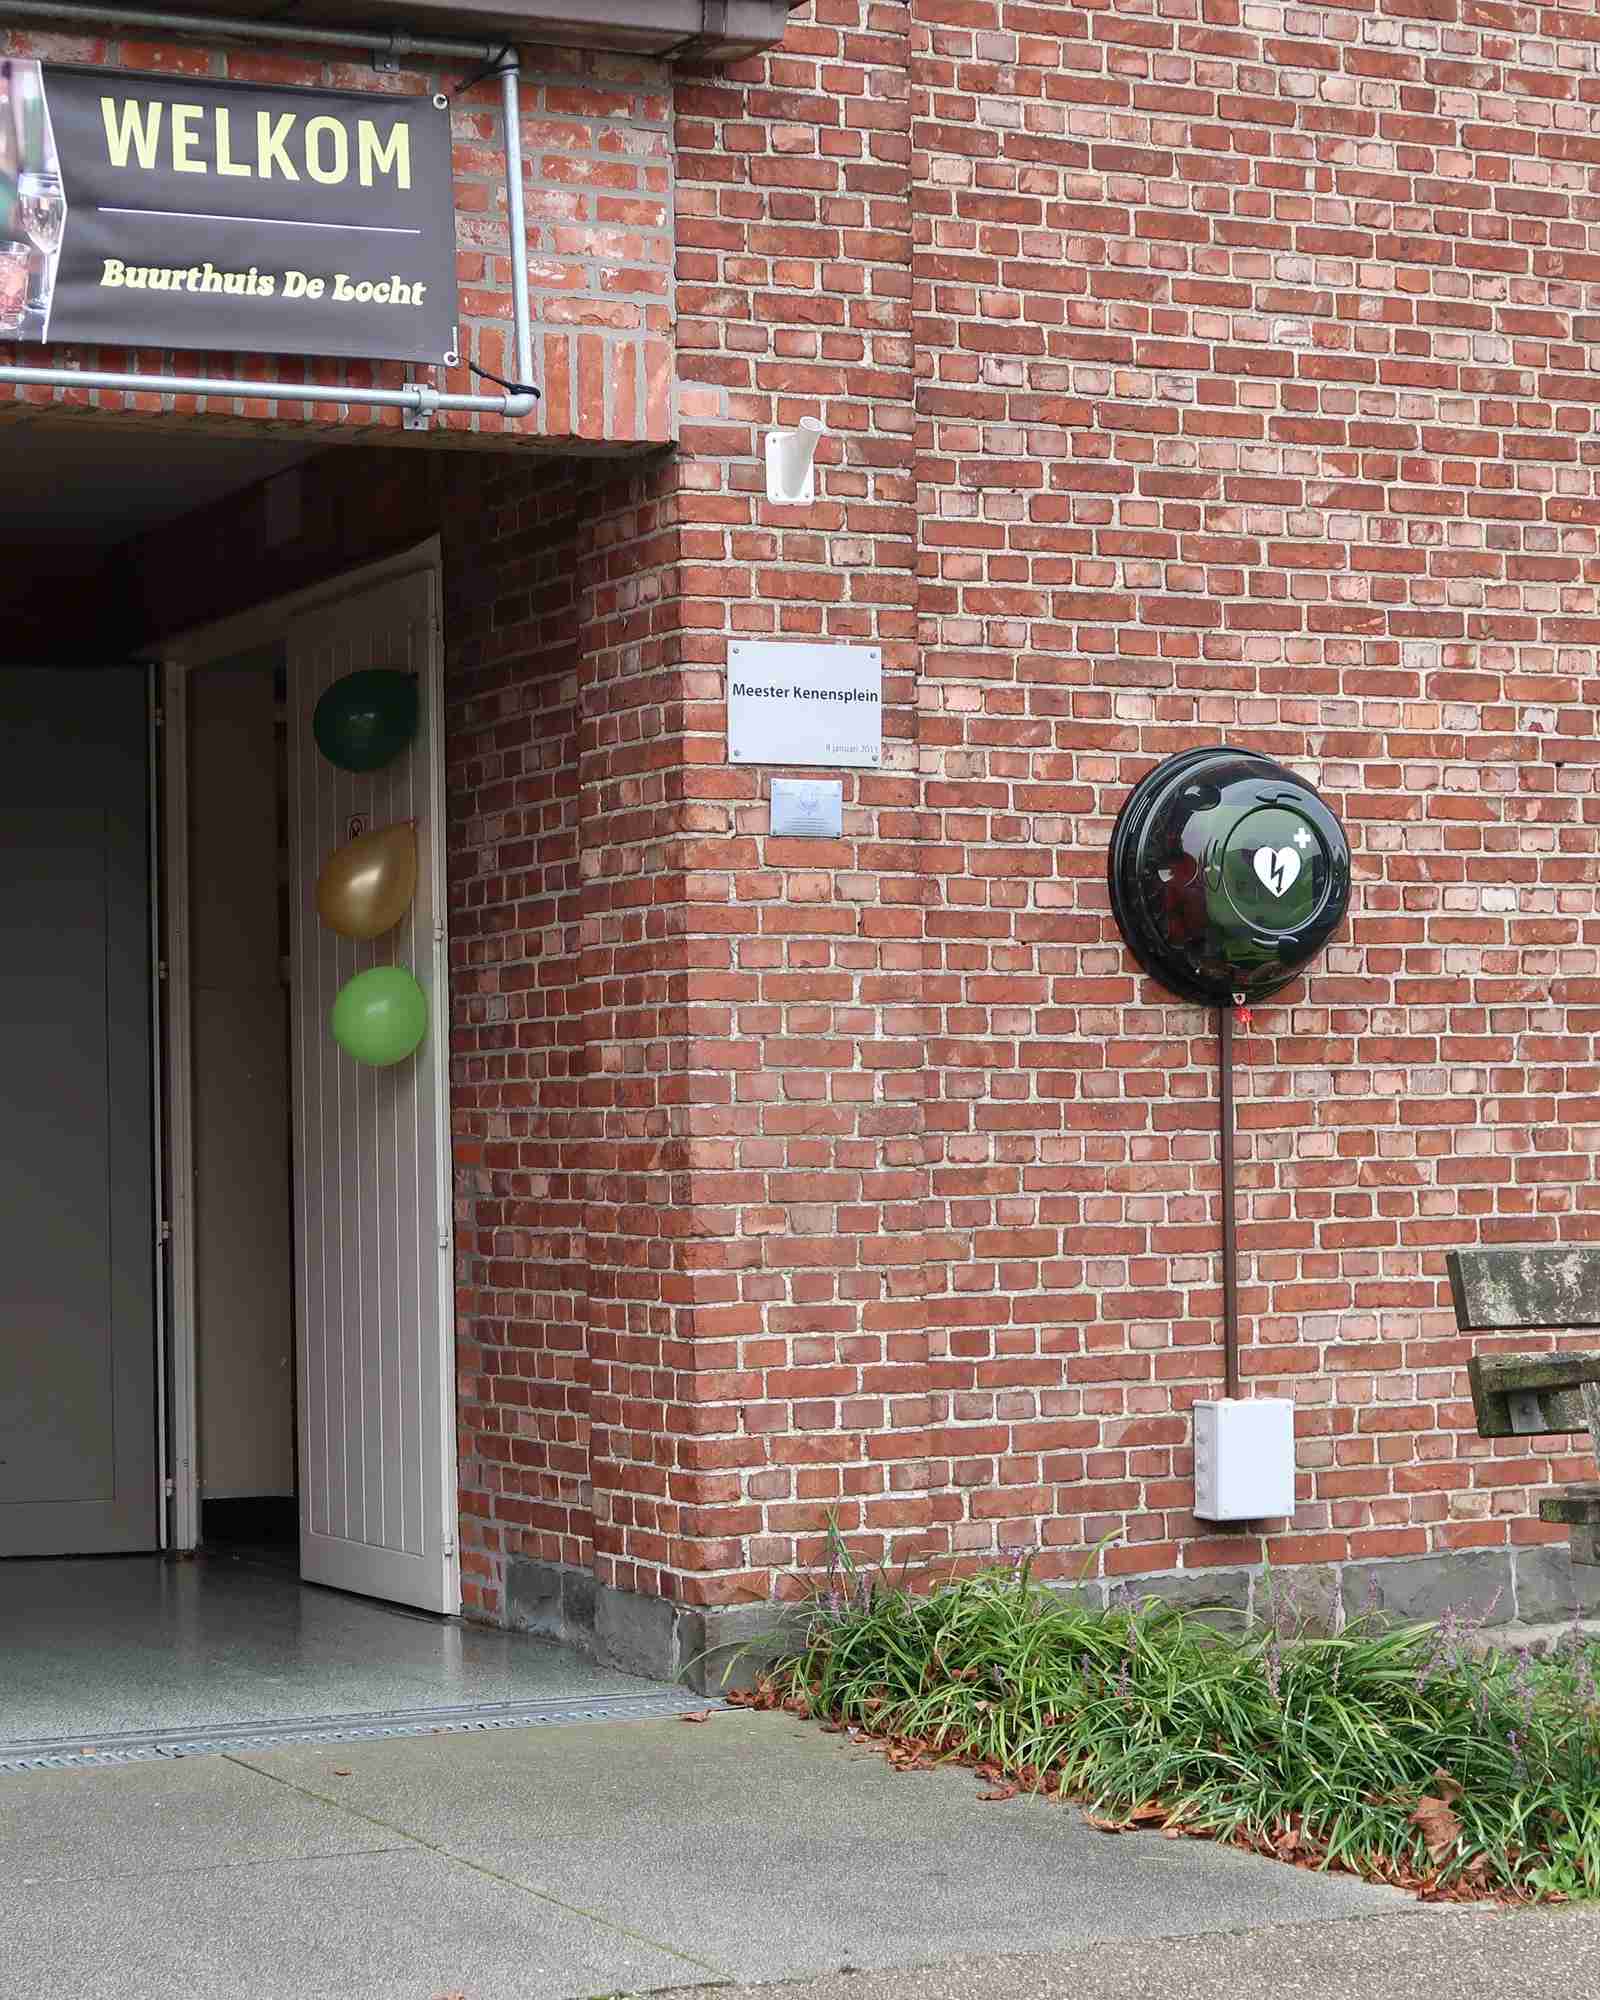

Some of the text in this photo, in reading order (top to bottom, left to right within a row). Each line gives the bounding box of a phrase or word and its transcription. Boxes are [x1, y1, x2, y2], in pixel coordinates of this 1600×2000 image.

[101, 97, 411, 189] WELKOM
[101, 259, 427, 306] Buurthuis De Locht
[733, 683, 878, 703] Meester Kenensplein
